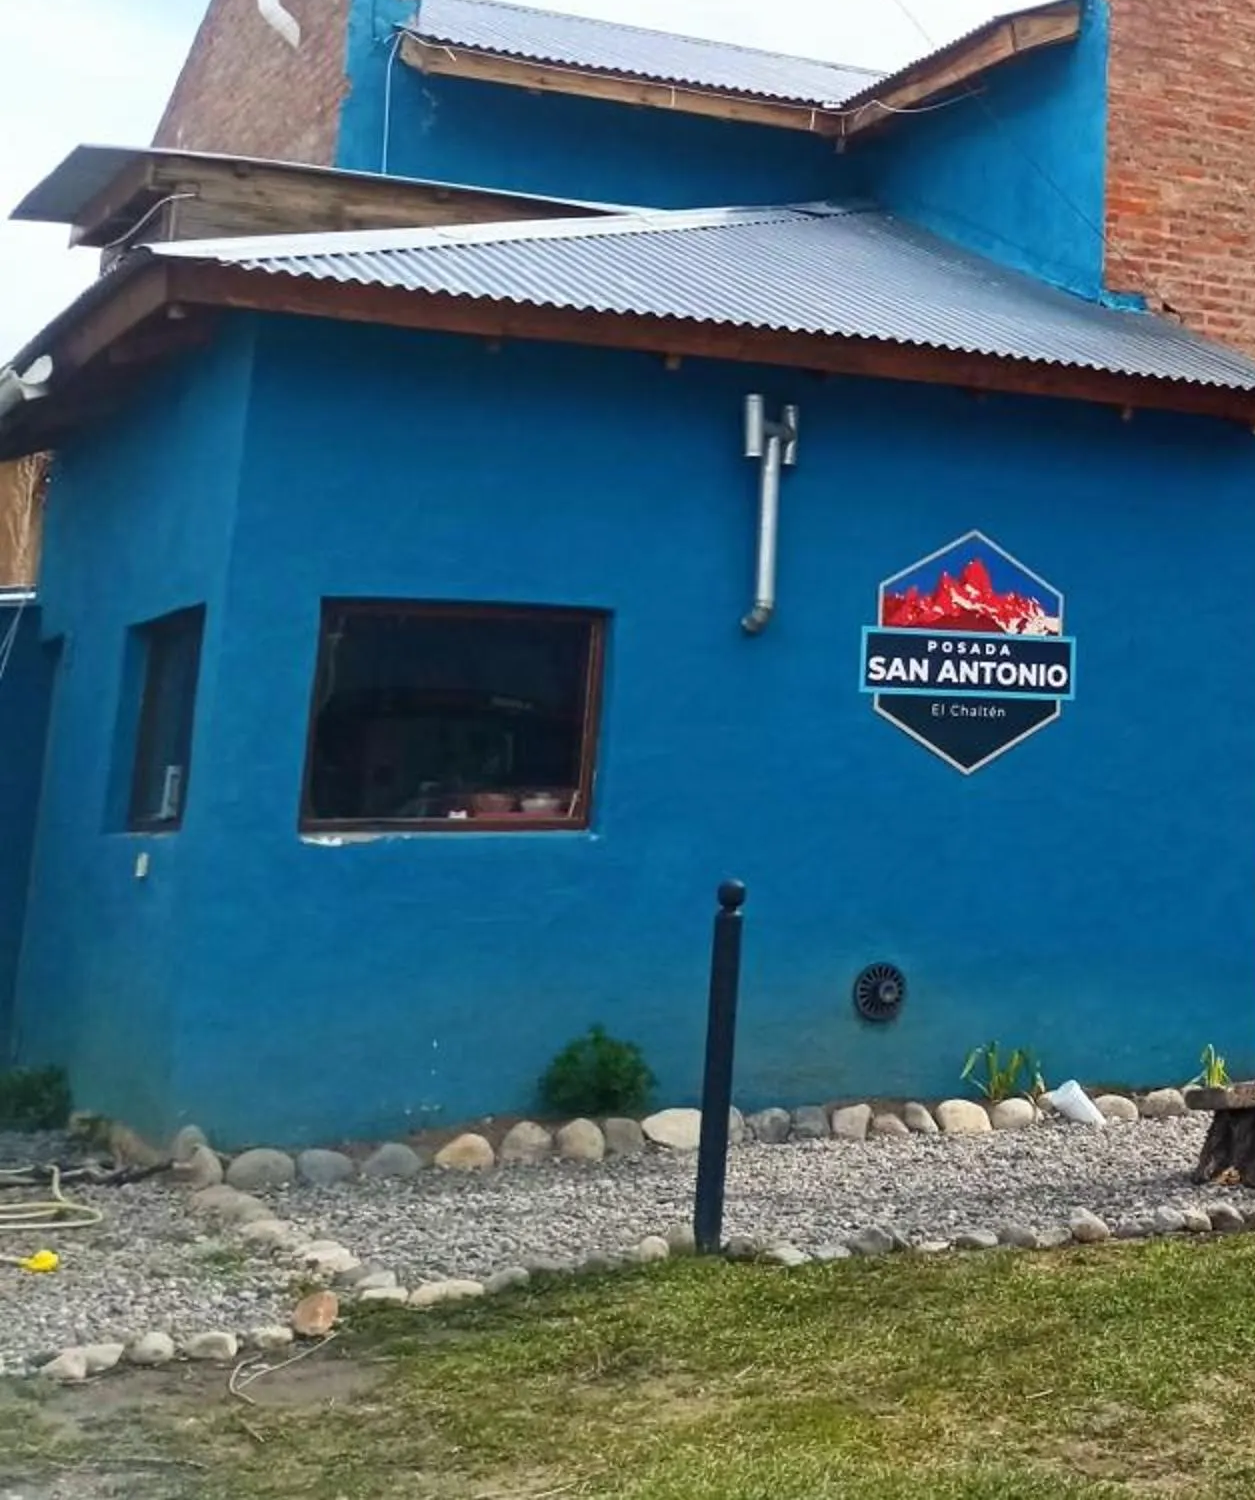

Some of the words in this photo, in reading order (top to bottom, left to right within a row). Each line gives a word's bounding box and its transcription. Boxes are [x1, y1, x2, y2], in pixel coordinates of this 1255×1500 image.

[927, 640, 1011, 656] POSADA
[868, 656, 929, 682] SAN
[937, 660, 1068, 687] ANTONIO
[931, 703, 945, 717] El
[950, 703, 1006, 718] Chaltén
